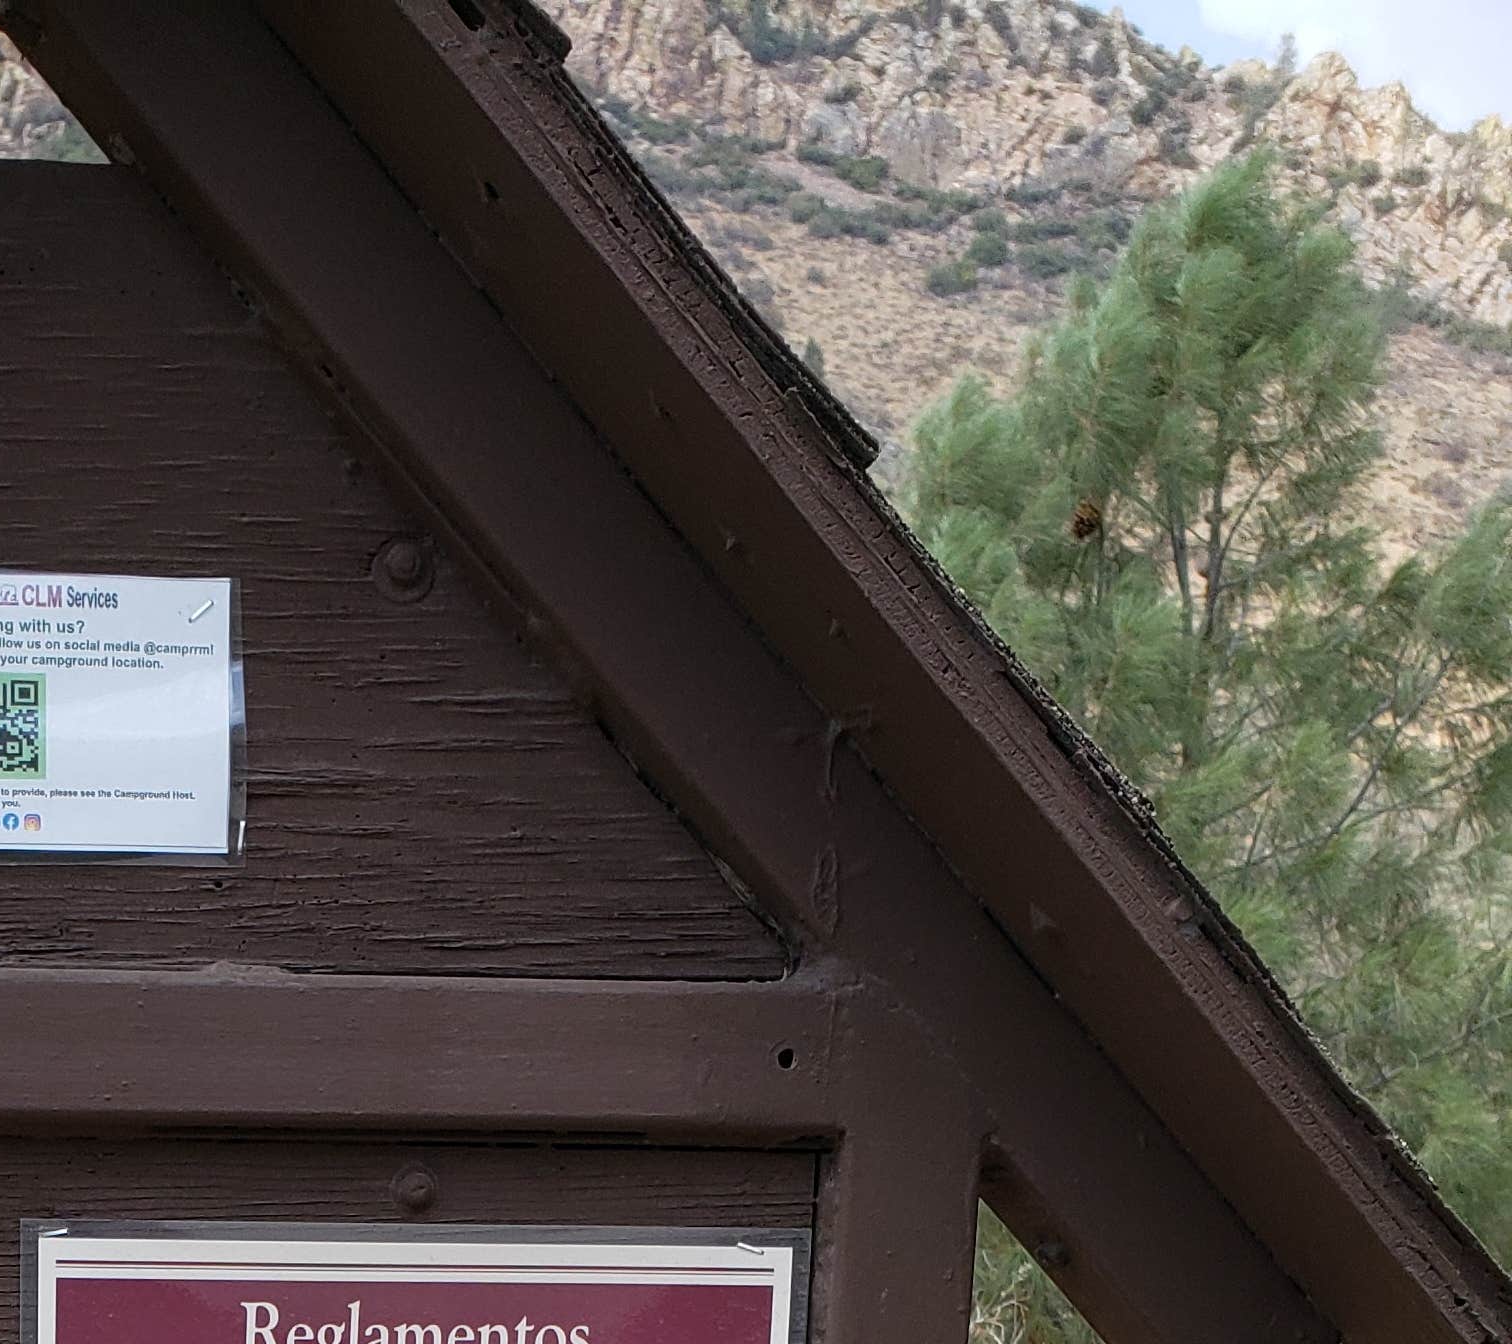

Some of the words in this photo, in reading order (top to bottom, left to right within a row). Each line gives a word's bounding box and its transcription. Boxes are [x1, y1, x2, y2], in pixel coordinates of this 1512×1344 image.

[21, 584, 62, 608] CLM
[65, 585, 118, 609] Services
[18, 617, 51, 633] with
[55, 619, 85, 634] us?
[26, 640, 42, 649] us
[44, 640, 61, 650] on
[63, 639, 100, 651] social
[102, 640, 140, 652] media
[0, 655, 29, 667] your
[31, 654, 108, 669] campground
[111, 655, 164, 669] location.
[0, 800, 21, 809] you.
